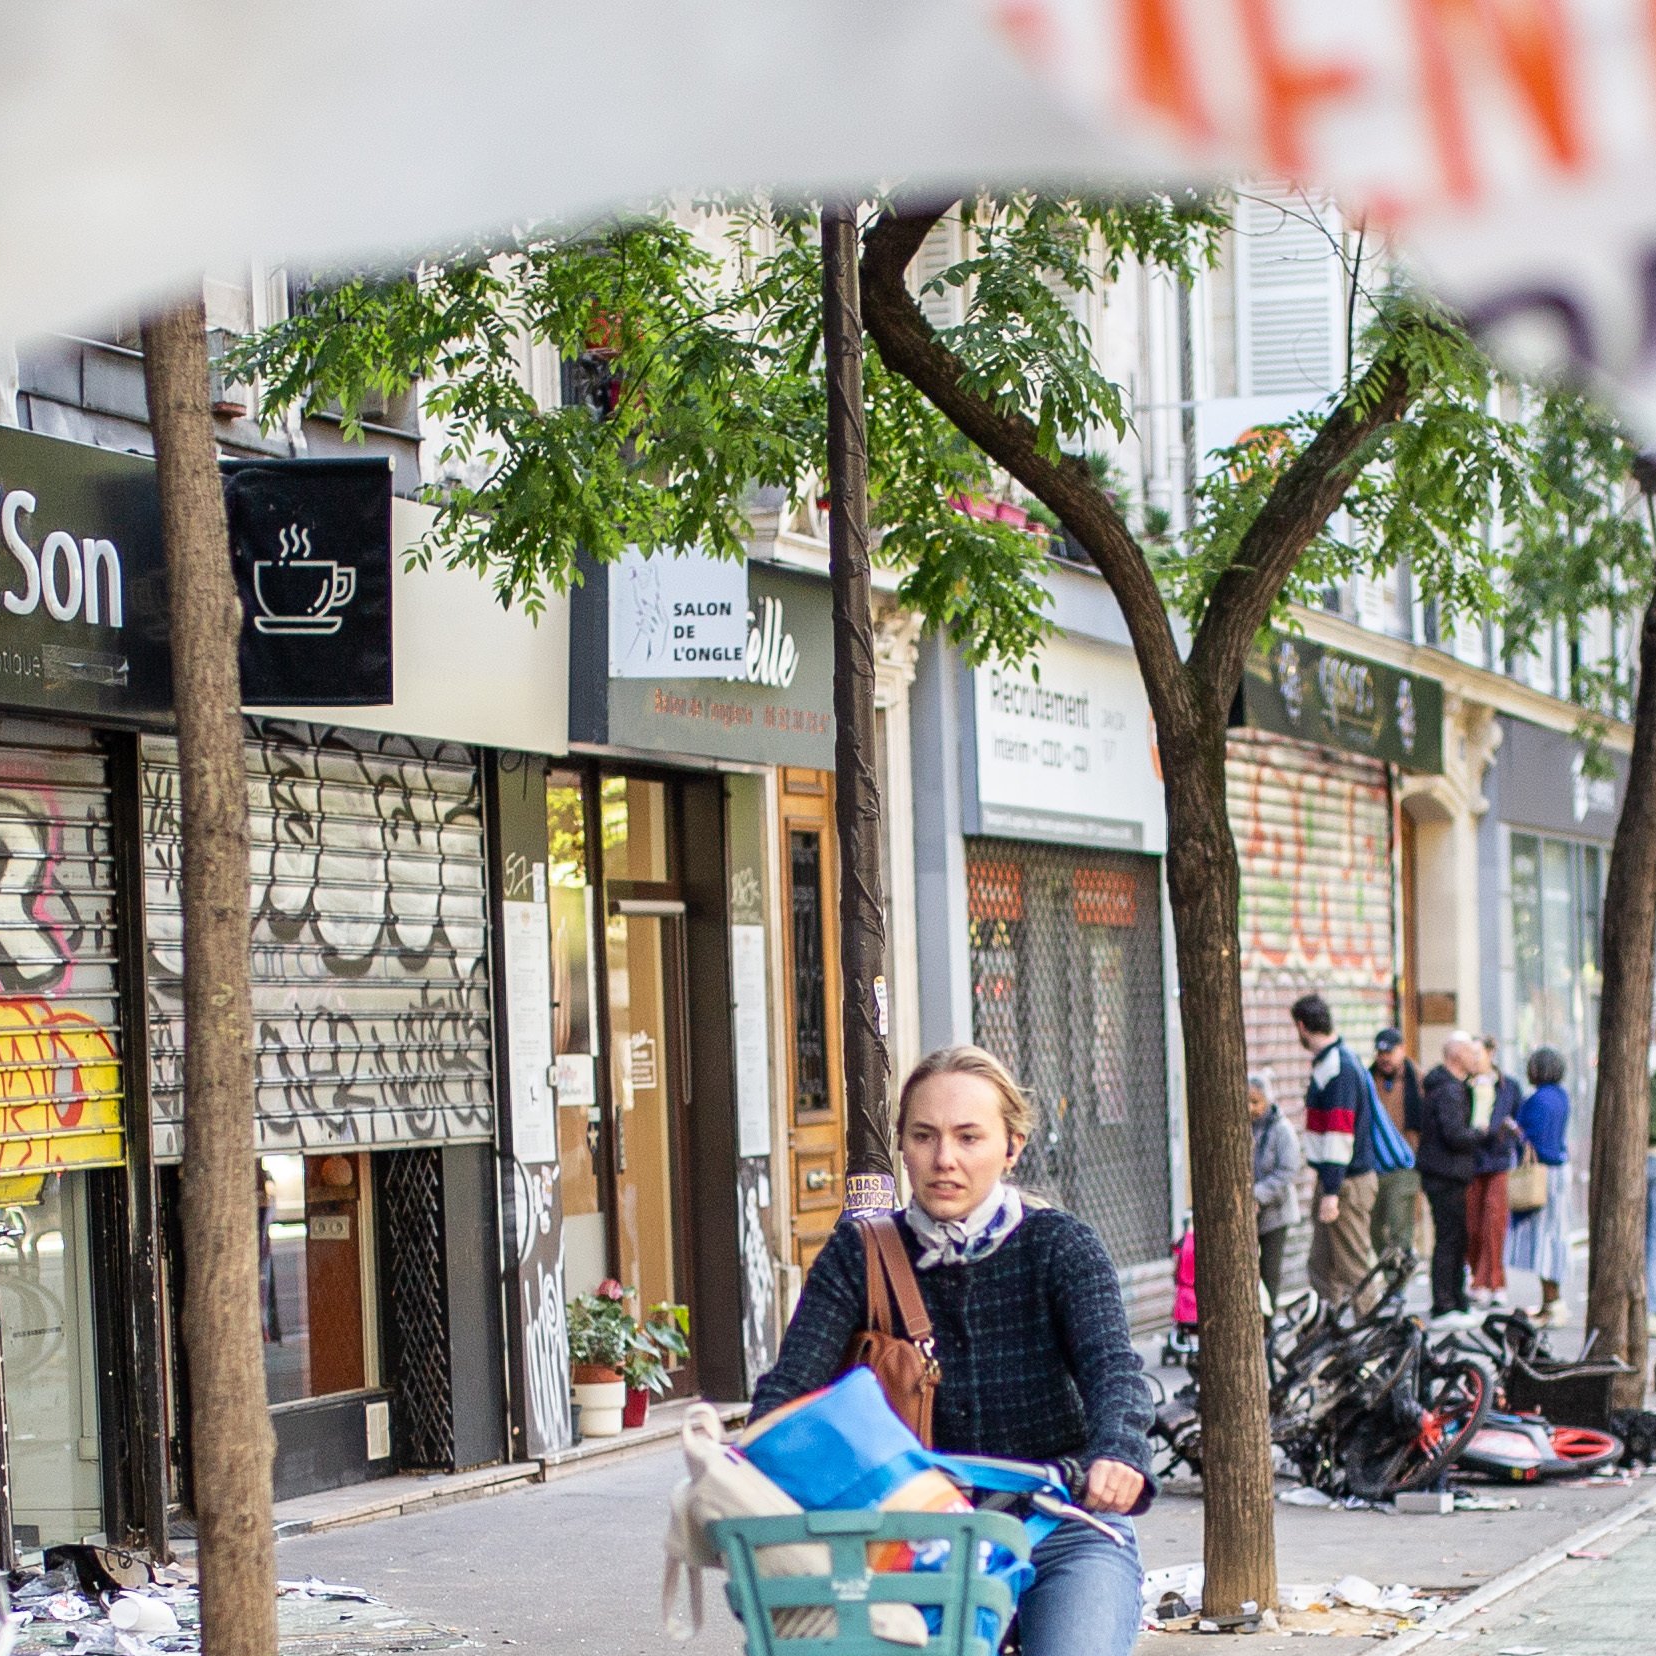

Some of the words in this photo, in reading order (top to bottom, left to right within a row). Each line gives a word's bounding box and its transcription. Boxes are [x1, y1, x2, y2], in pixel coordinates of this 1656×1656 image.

[674, 603, 732, 616] SALON
[674, 625, 695, 639] DE
[674, 647, 742, 661] L'ONGLE
[991, 669, 1090, 729] Recrutement
